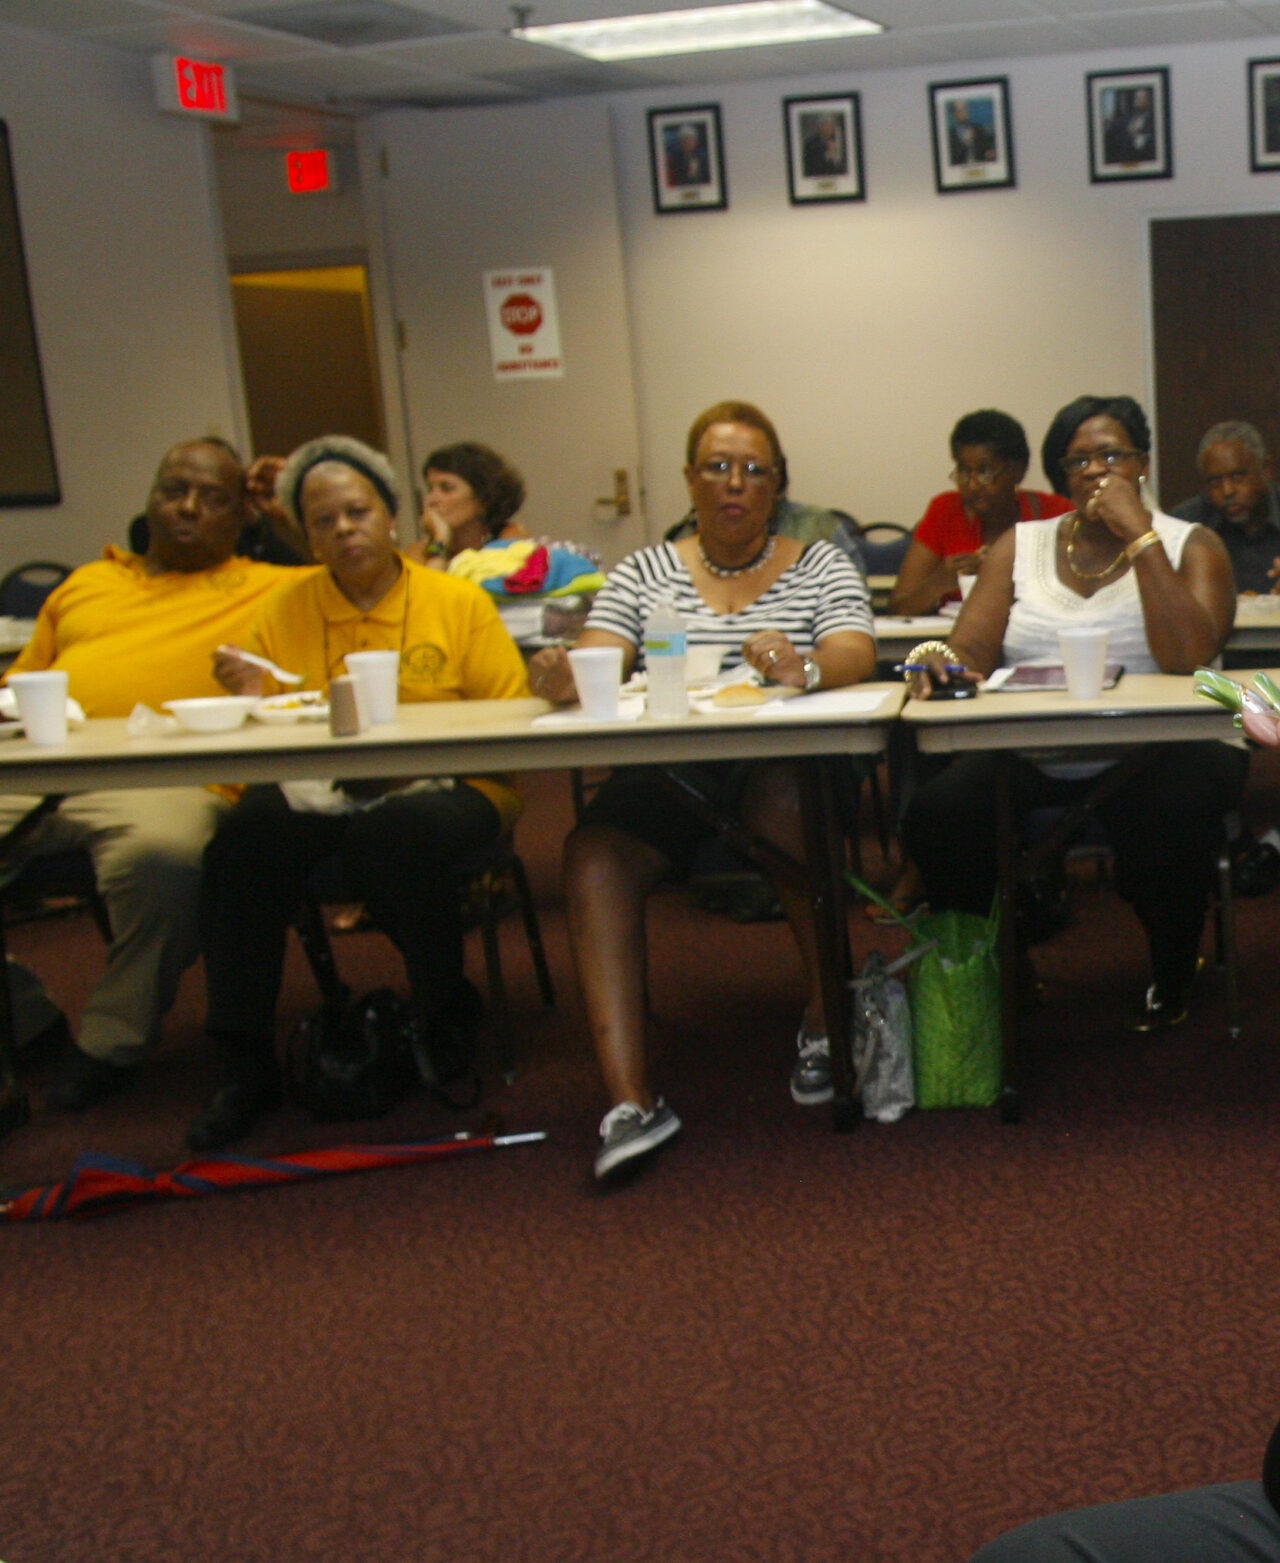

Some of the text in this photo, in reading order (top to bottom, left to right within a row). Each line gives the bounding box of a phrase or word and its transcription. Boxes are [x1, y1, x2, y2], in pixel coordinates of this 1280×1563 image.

[176, 57, 226, 114] EXIT
[287, 150, 328, 193] EXIT
[502, 306, 538, 322] STOP
